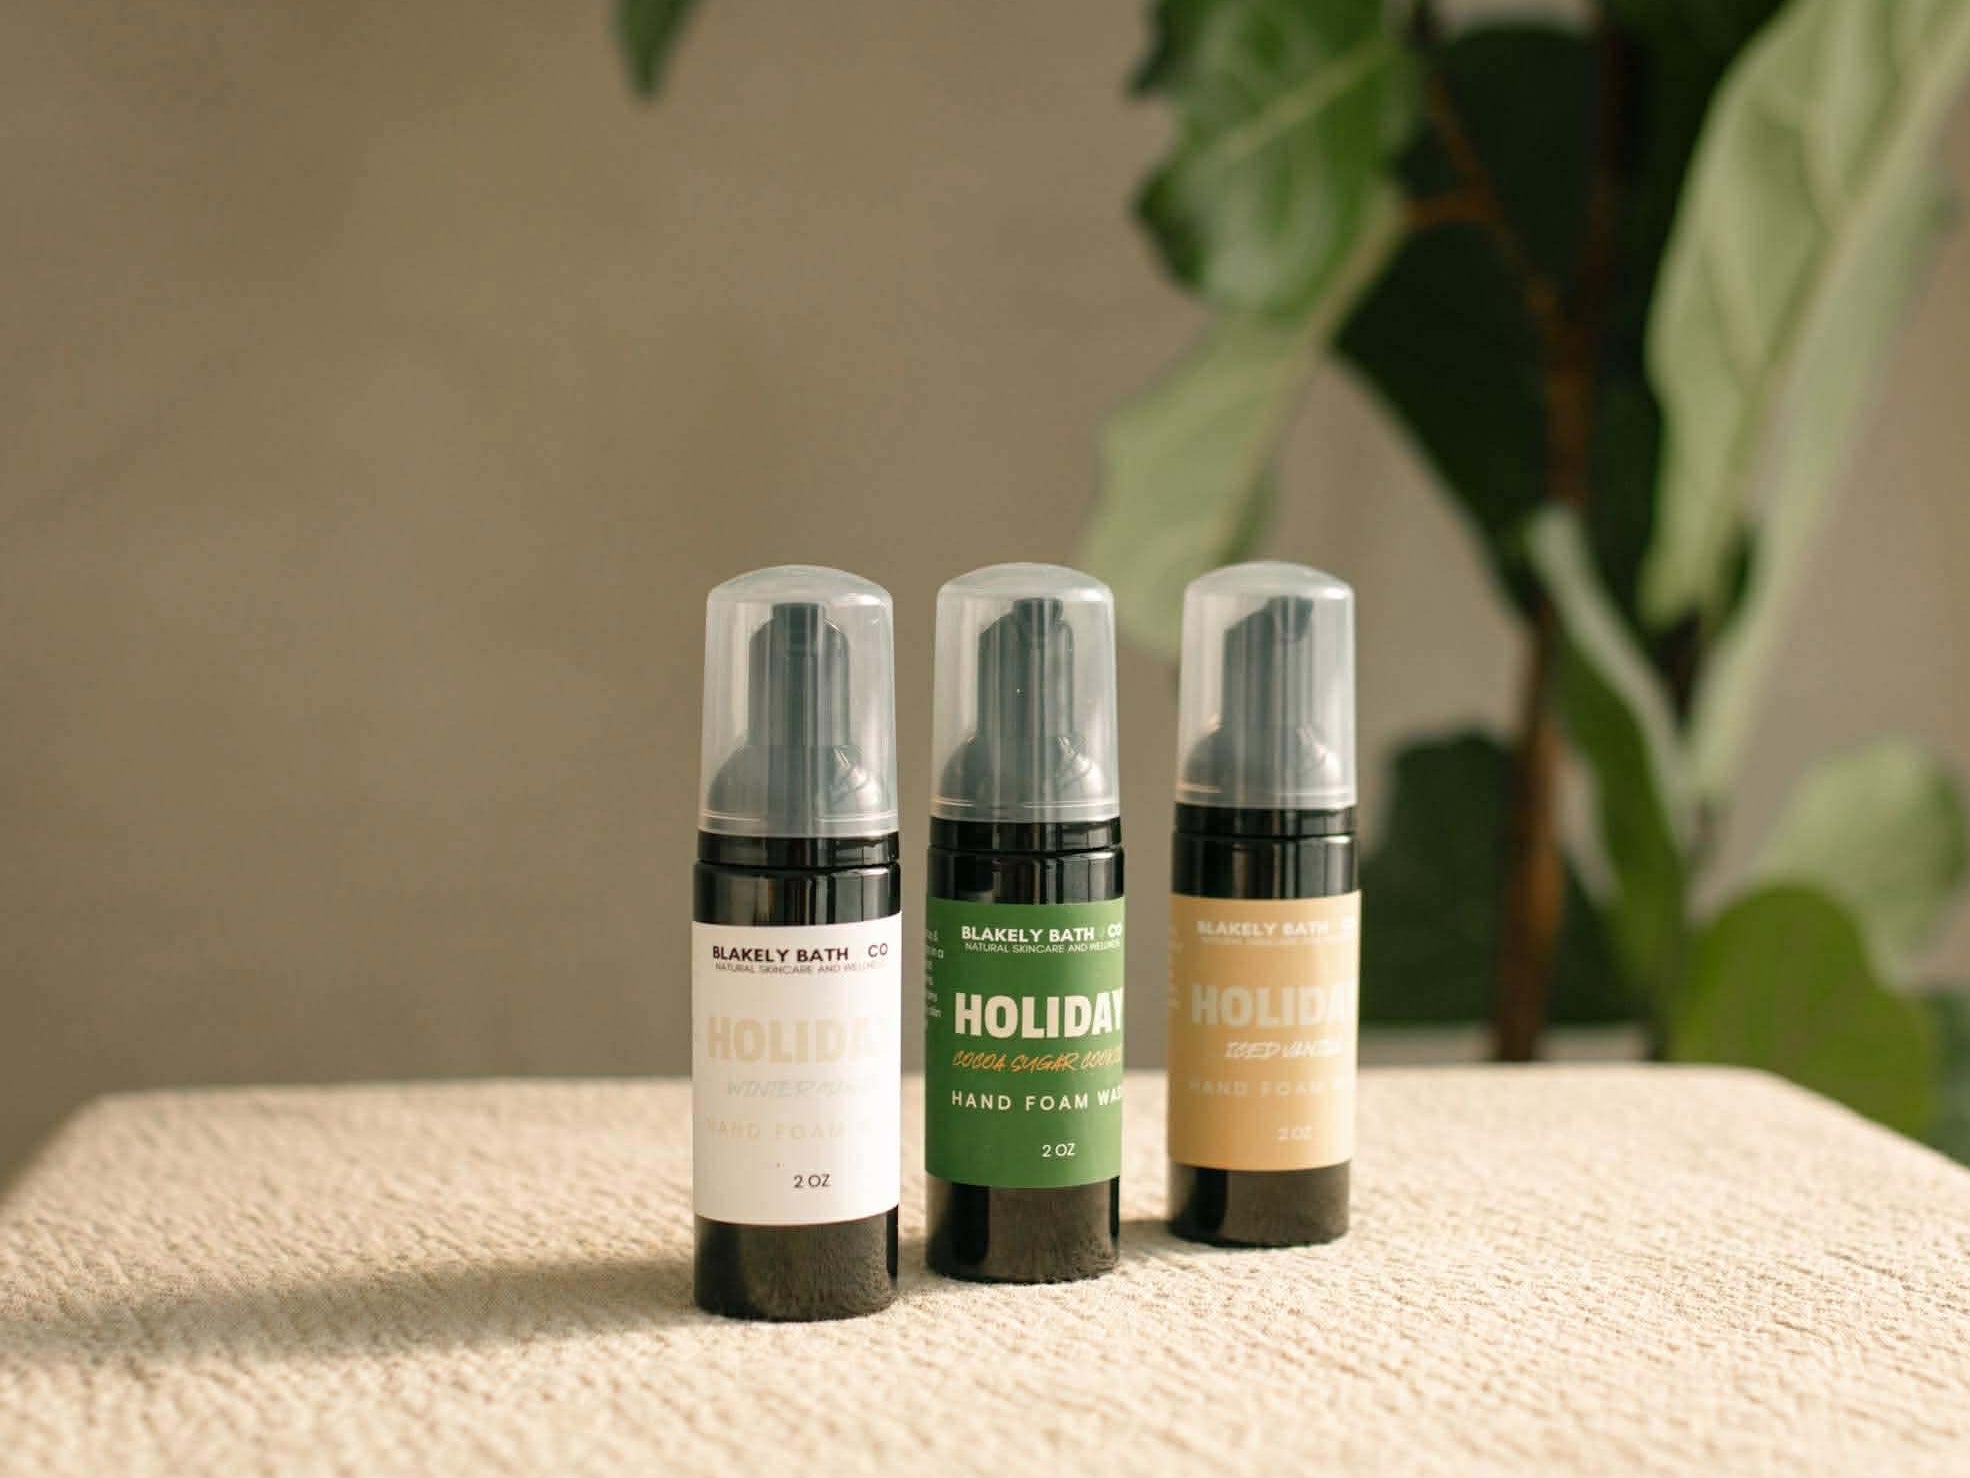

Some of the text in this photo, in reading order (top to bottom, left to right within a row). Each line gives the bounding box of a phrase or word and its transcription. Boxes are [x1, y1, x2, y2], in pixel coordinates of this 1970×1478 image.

[961, 925, 1043, 943] BLAKELY
[1049, 926, 1095, 943] BATH
[1196, 920, 1279, 936] BLAKELY
[1282, 921, 1329, 936] BATH
[712, 943, 889, 963] BLAKELY BATH CO
[964, 942, 1009, 954] NATURAL
[1012, 944, 1065, 954] SKINCARE
[1067, 943, 1088, 953] AND
[715, 962, 755, 974] NATURAL
[759, 964, 813, 976] SKINCARE
[817, 963, 841, 975] AND
[707, 1015, 880, 1064] HOLIDA
[952, 1050, 1007, 1072] COCOA
[1010, 1051, 1081, 1074] SUGAR
[951, 1089, 1012, 1111] HAND
[1025, 1093, 1089, 1111] FOAM
[1042, 1143, 1076, 1158] 2 OZ
[793, 1173, 831, 1188] 2 OZ
